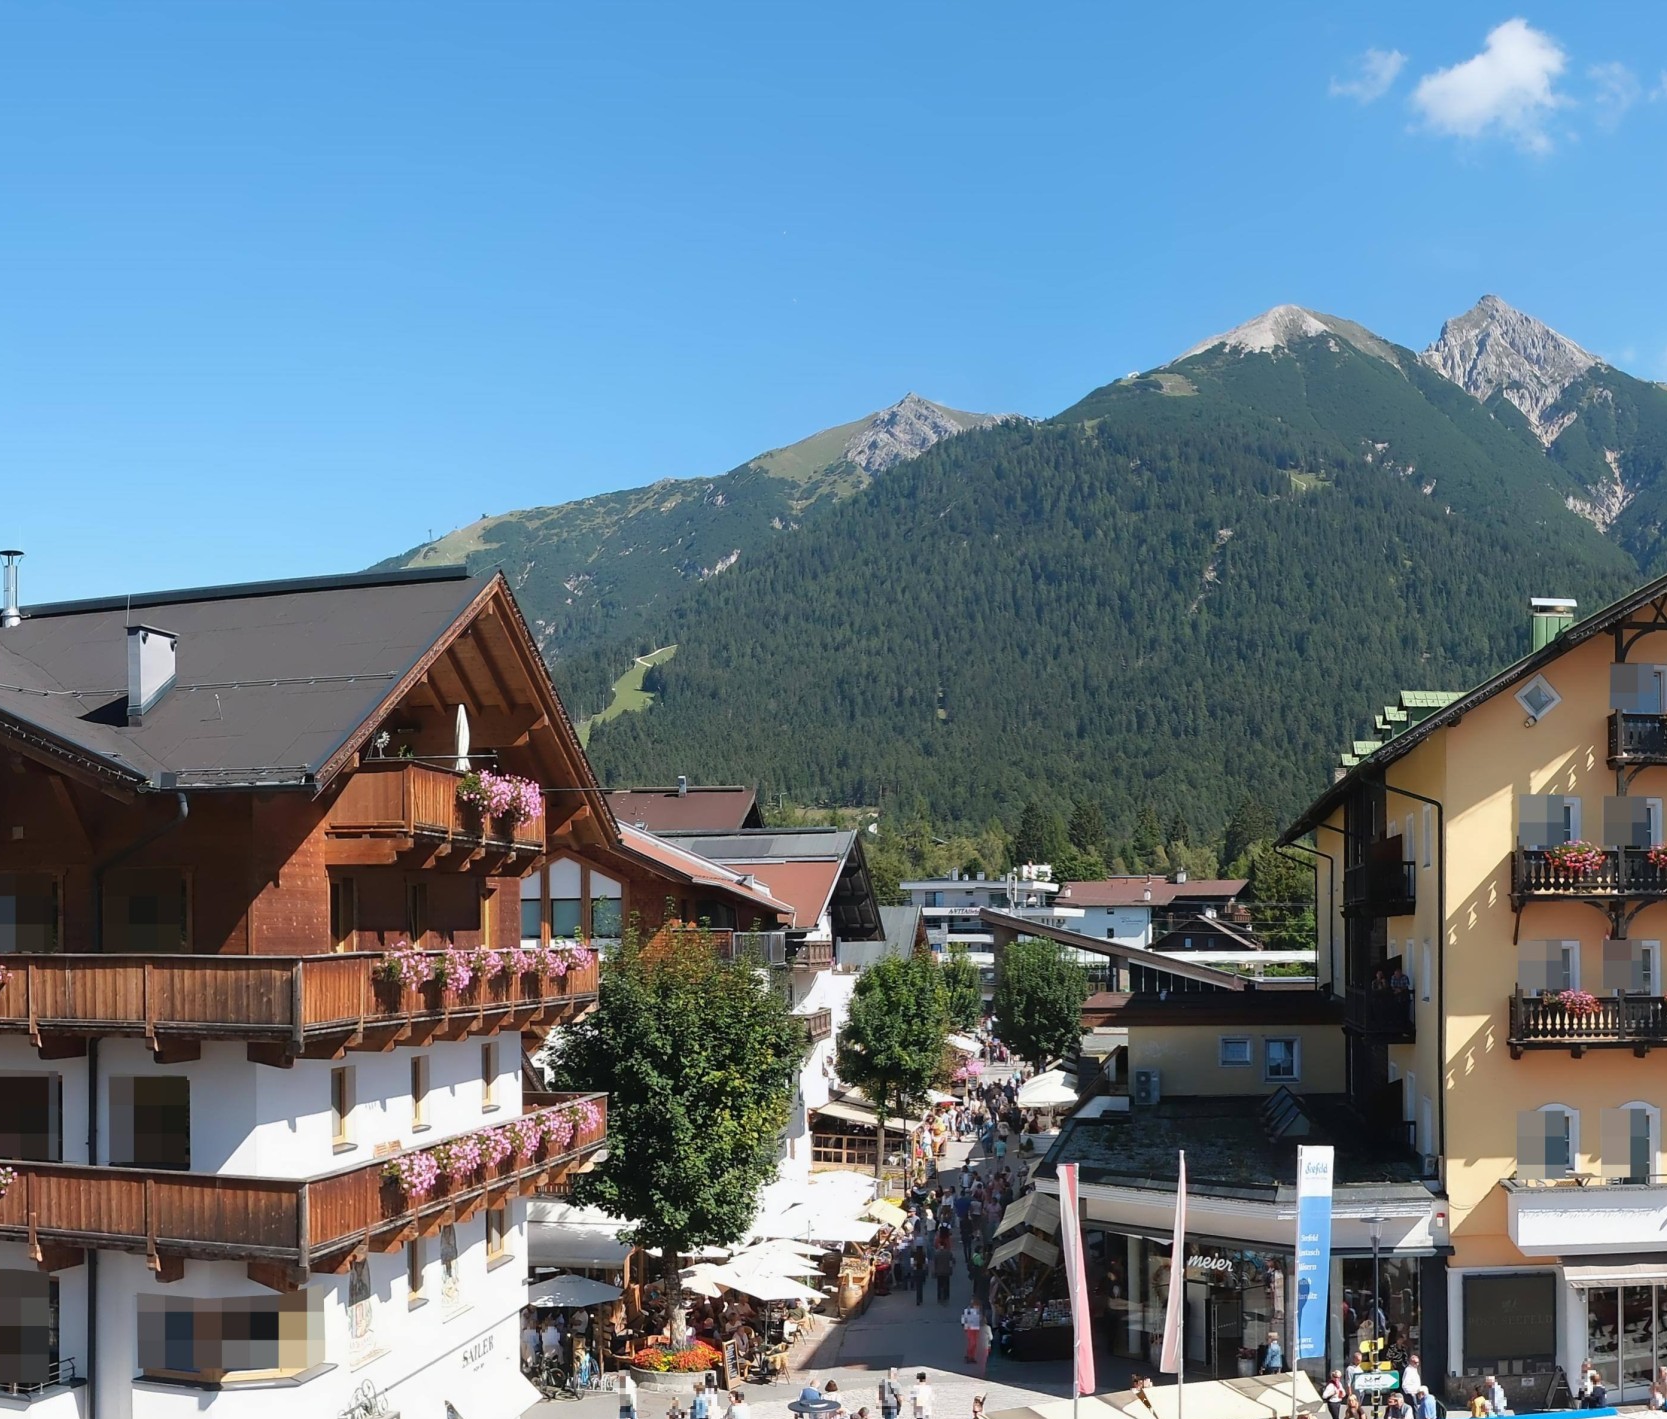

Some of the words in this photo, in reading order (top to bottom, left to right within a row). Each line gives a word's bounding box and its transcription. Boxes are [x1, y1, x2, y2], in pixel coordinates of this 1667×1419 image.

[1305, 1162, 1328, 1176] Seefeld
[1187, 1252, 1234, 1272] meier
[462, 1335, 494, 1369] SAILER
